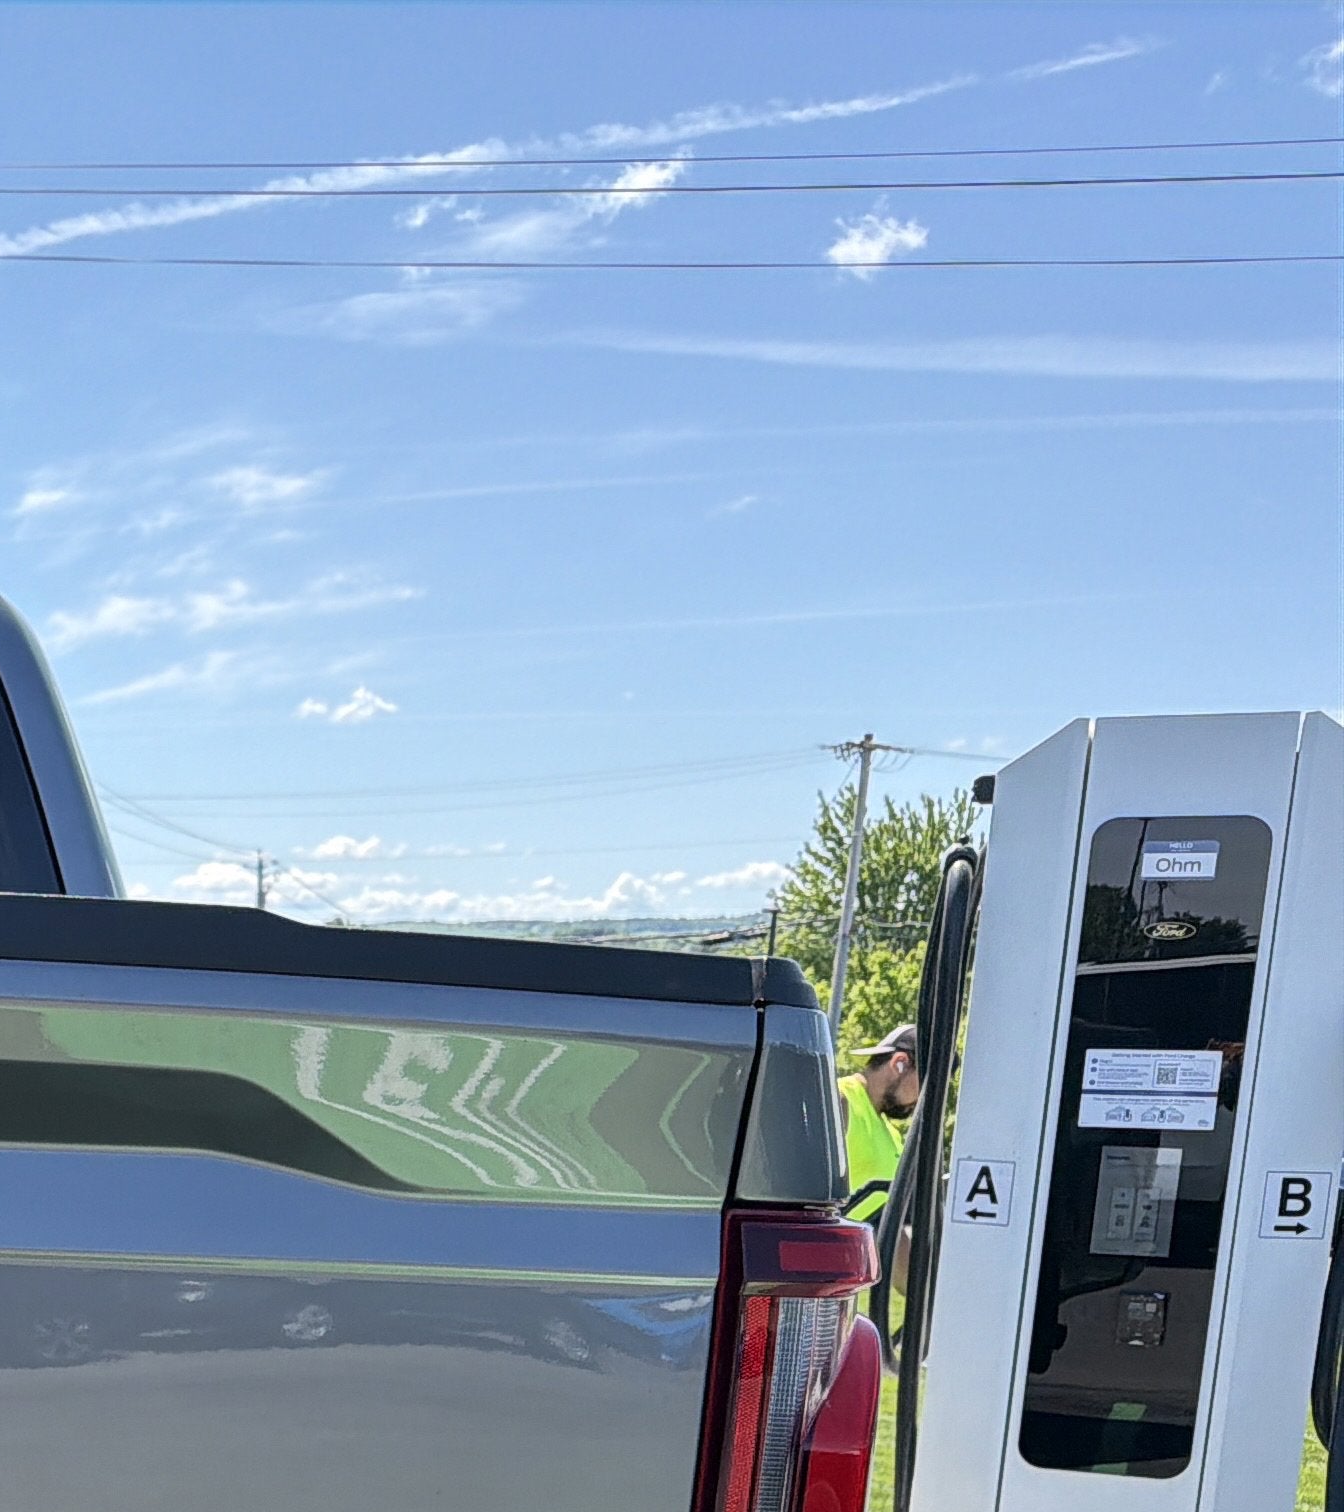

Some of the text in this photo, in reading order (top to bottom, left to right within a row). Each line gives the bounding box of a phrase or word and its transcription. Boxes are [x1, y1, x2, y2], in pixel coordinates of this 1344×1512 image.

[1155, 857, 1202, 873] Ohm
[1152, 924, 1187, 937] Ford
[965, 1165, 999, 1205] A
[1277, 1176, 1313, 1218] B
